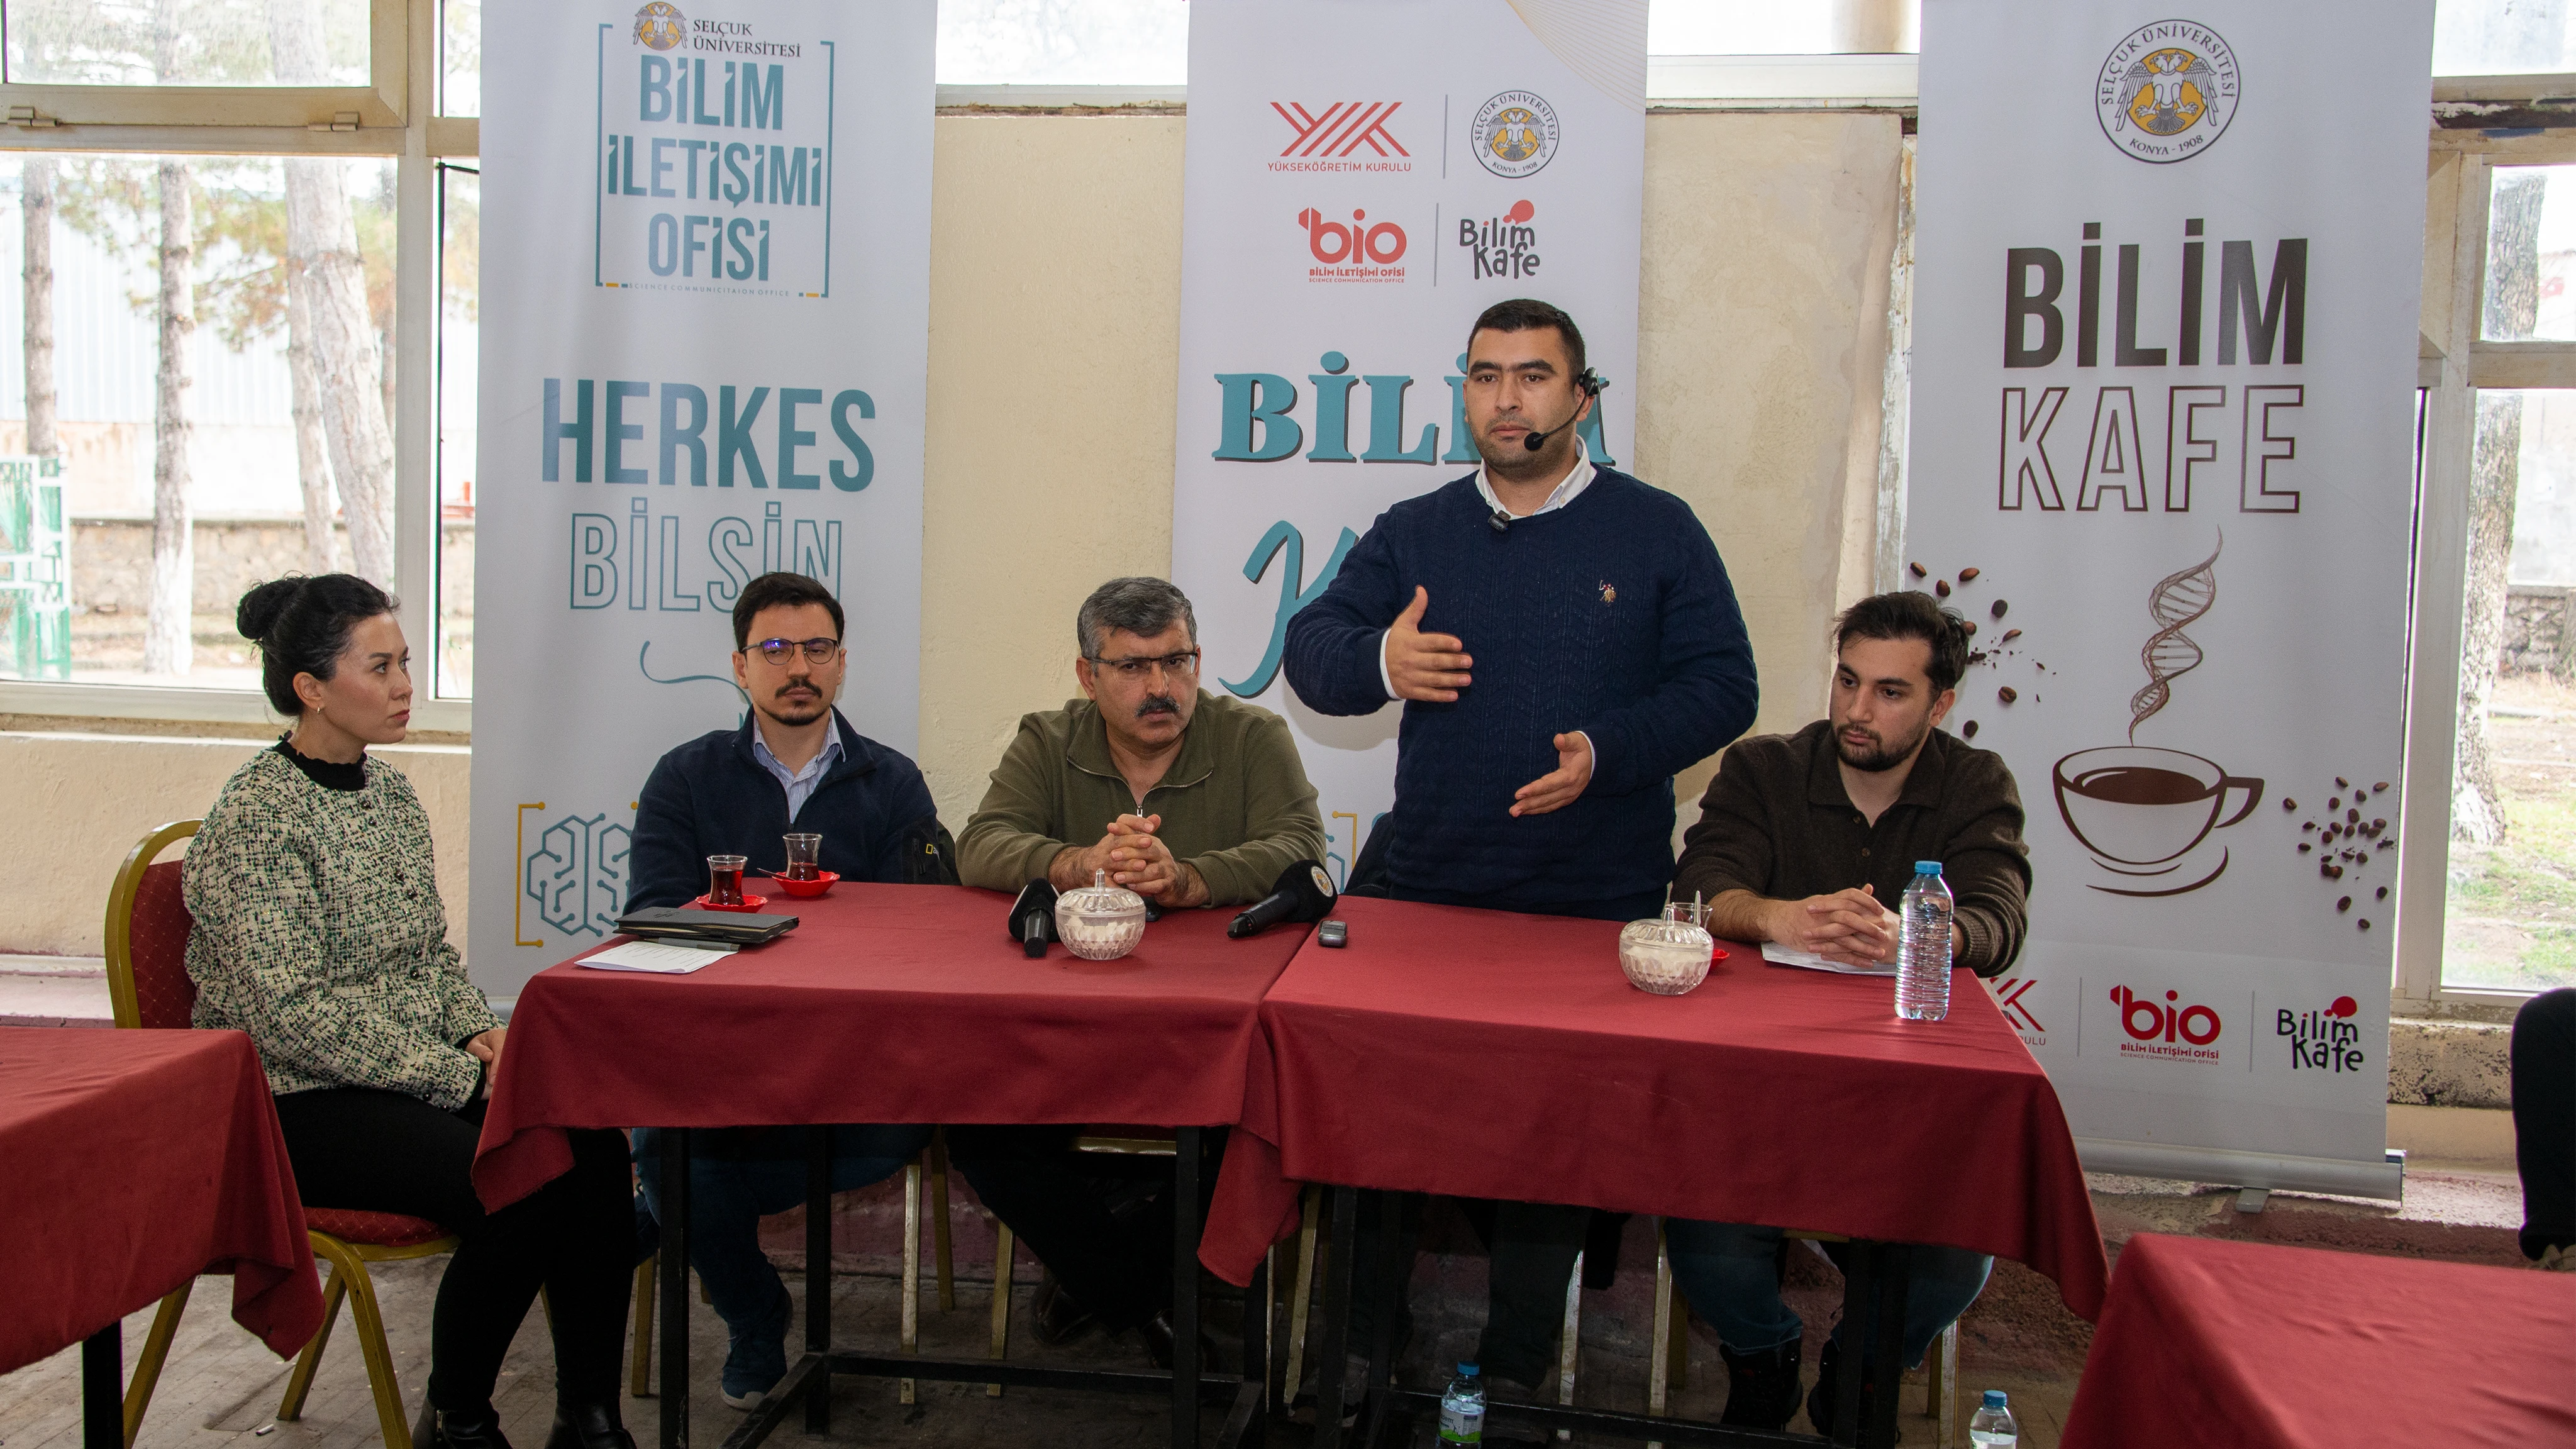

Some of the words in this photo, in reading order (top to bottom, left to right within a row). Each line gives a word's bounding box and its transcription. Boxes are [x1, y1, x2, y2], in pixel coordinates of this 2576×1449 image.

[693, 19, 753, 38] SELÇUK
[693, 35, 802, 58] ÜNİVERSİTESİ
[2101, 39, 2141, 105] SELÇUK
[2141, 23, 2236, 98] ÜNİVERSİTESİ
[640, 54, 784, 131] BİLİM
[1475, 101, 1499, 141] SELÇUK
[1499, 93, 1557, 140] ÜNİVERSİTESİ
[2129, 138, 2169, 155] KONYA
[2179, 134, 2204, 152] 1908
[608, 134, 822, 209] İLETİŞİMİ
[1268, 161, 1362, 172] YÜKSEKÖĞRETİM
[1366, 162, 1411, 172] KURULU
[1492, 162, 1517, 174] KONYA
[1523, 161, 1538, 172] 1908
[648, 213, 770, 281] OFİSİ
[1299, 207, 1407, 264] bio
[1459, 217, 1536, 249] Bilim
[1309, 267, 1335, 277] BİLİM
[1336, 267, 1378, 278] İLETİŞİMİ
[1380, 267, 1405, 277] OFİSİ
[1473, 242, 1541, 280] Kafe
[629, 282, 667, 291] SCIENCE
[758, 289, 789, 297] OFFICE
[2004, 218, 2308, 369] BİLİM
[1212, 351, 1616, 466] BİLİ
[542, 378, 876, 492] HERKES
[1999, 384, 2304, 513] KAFE
[2110, 984, 2221, 1045] bio
[2277, 1009, 2358, 1043] Bilim
[2121, 1042, 2146, 1053] BİLİM
[2148, 1044, 2192, 1057] İLETİŞİMİ
[2194, 1050, 2219, 1059] OFİSİ
[2146, 1054, 2196, 1063] COMMUNICATION
[2292, 1034, 2364, 1073] Kafe
